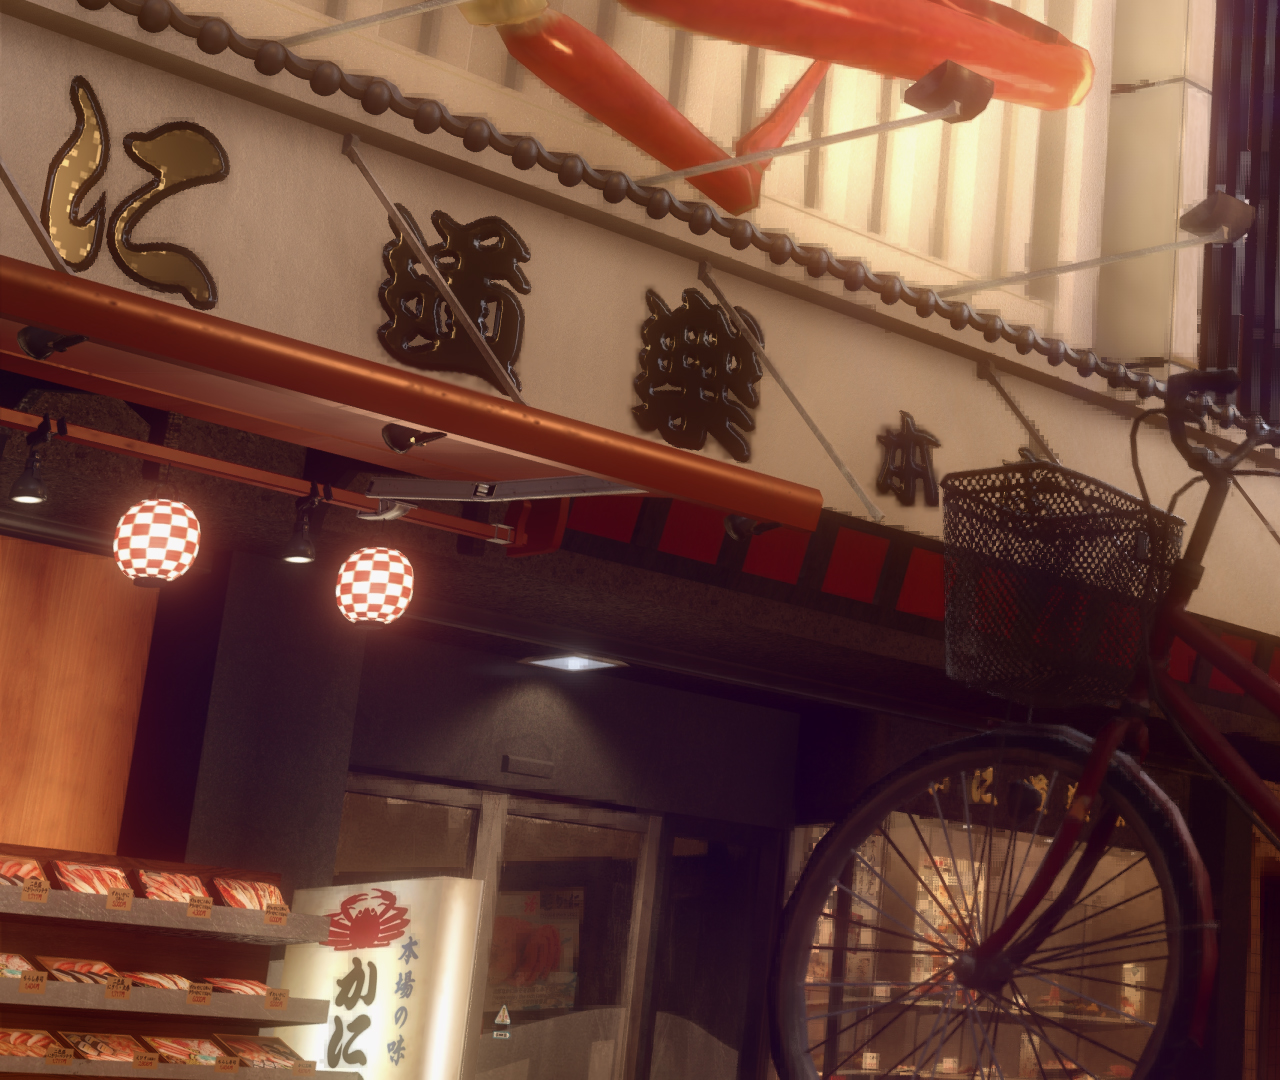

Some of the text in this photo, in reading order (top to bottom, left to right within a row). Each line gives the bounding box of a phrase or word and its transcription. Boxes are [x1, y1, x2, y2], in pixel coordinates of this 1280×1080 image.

[327, 956, 377, 1069] かに
[387, 935, 419, 1067] 本場の味
